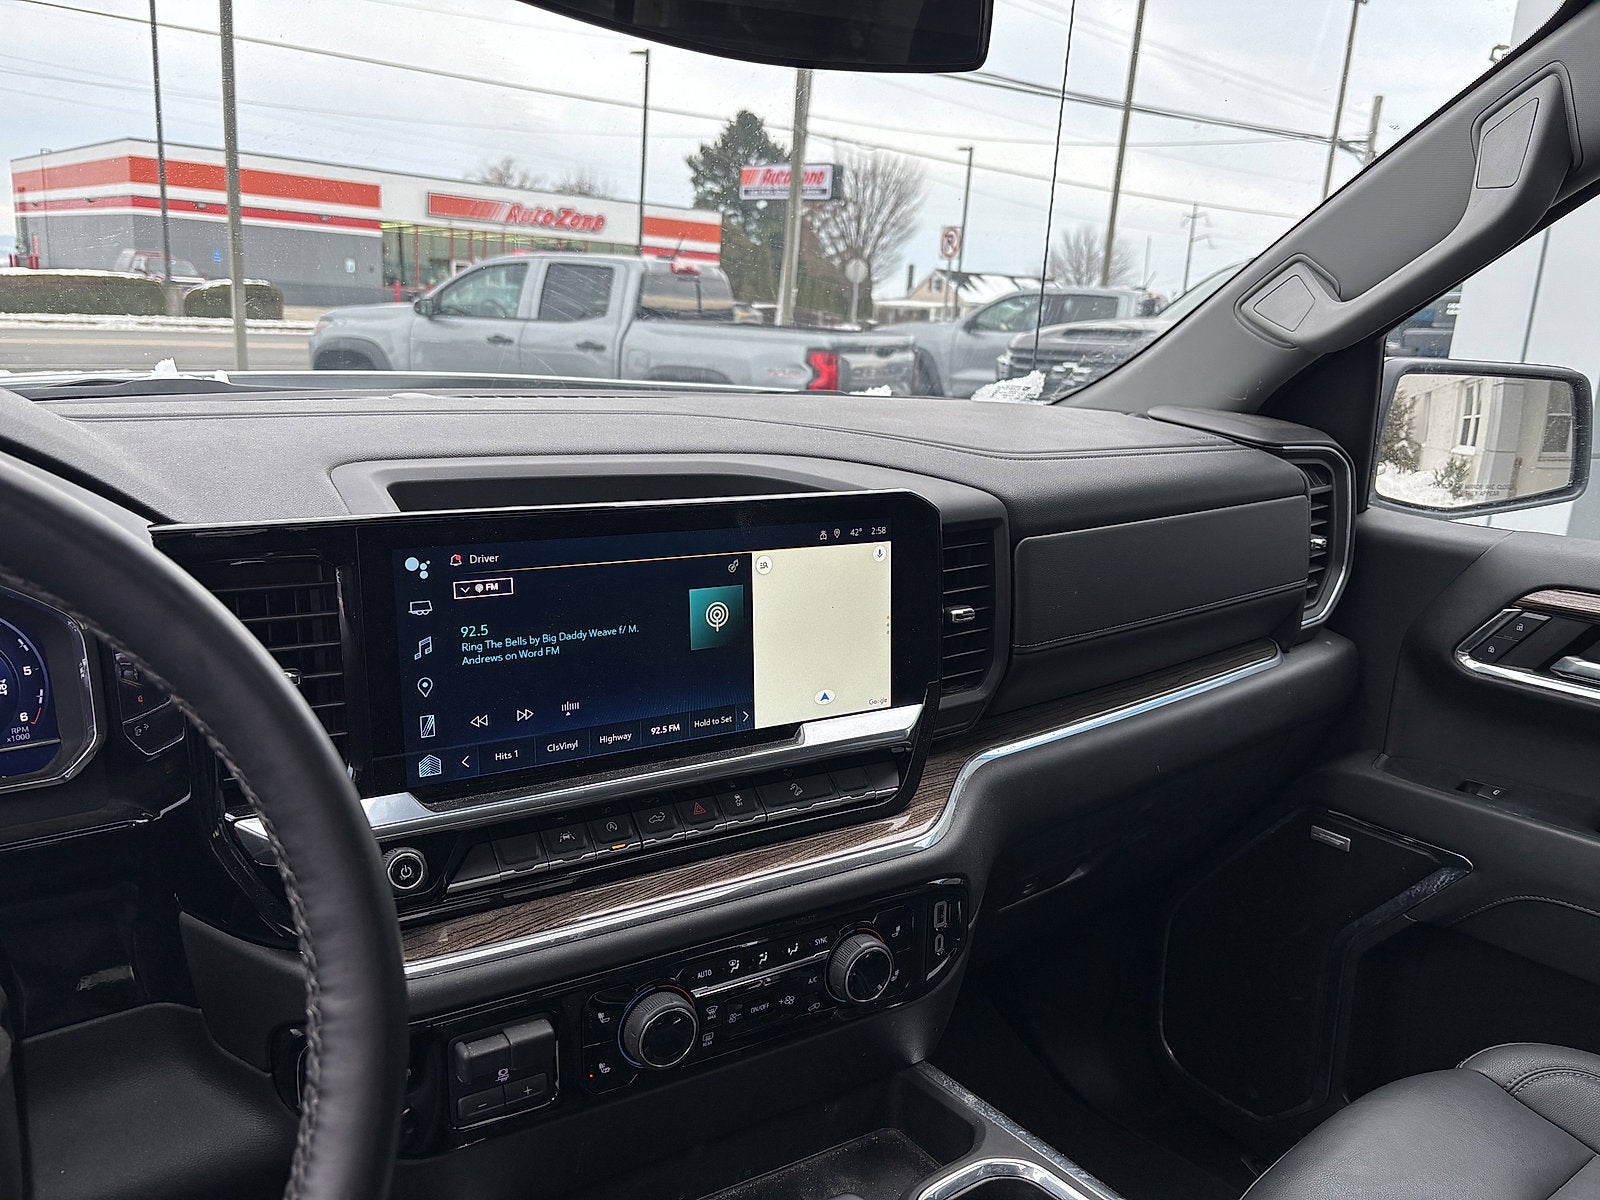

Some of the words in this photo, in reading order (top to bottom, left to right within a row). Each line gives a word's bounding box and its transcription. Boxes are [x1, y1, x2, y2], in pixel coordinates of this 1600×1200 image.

[505, 203, 606, 232] AutoZone
[871, 526, 886, 535] 2:58
[469, 553, 500, 565] Driver
[485, 582, 499, 592] FM
[460, 624, 490, 638] 92.5
[461, 640, 484, 653] Ring
[485, 638, 503, 650] The
[505, 636, 528, 648] Bells
[529, 634, 541, 648] by
[542, 632, 557, 648] Big
[558, 628, 588, 645] Daddy
[588, 626, 617, 638] Weave
[618, 624, 627, 636] f/
[628, 624, 640, 634] M.
[461, 655, 504, 666] Andrews
[505, 653, 518, 662] on
[519, 649, 544, 660] Word
[545, 646, 561, 657] FM
[22, 665, 33, 676] 5
[868, 697, 888, 706] Google
[19, 711, 29, 722] 6
[693, 718, 712, 729] Hold
[712, 718, 720, 727] to
[721, 715, 733, 726] Set
[11, 726, 29, 735] RPM
[650, 725, 668, 736] 92.5
[668, 722, 681, 733] FM
[6, 732, 30, 743] x1000
[599, 732, 633, 746] Highway
[495, 752, 513, 762] Hits
[514, 750, 519, 759] 1
[814, 936, 828, 946] SYNC
[697, 969, 712, 979] AUTO
[750, 1003, 771, 1014] ON/OFF
